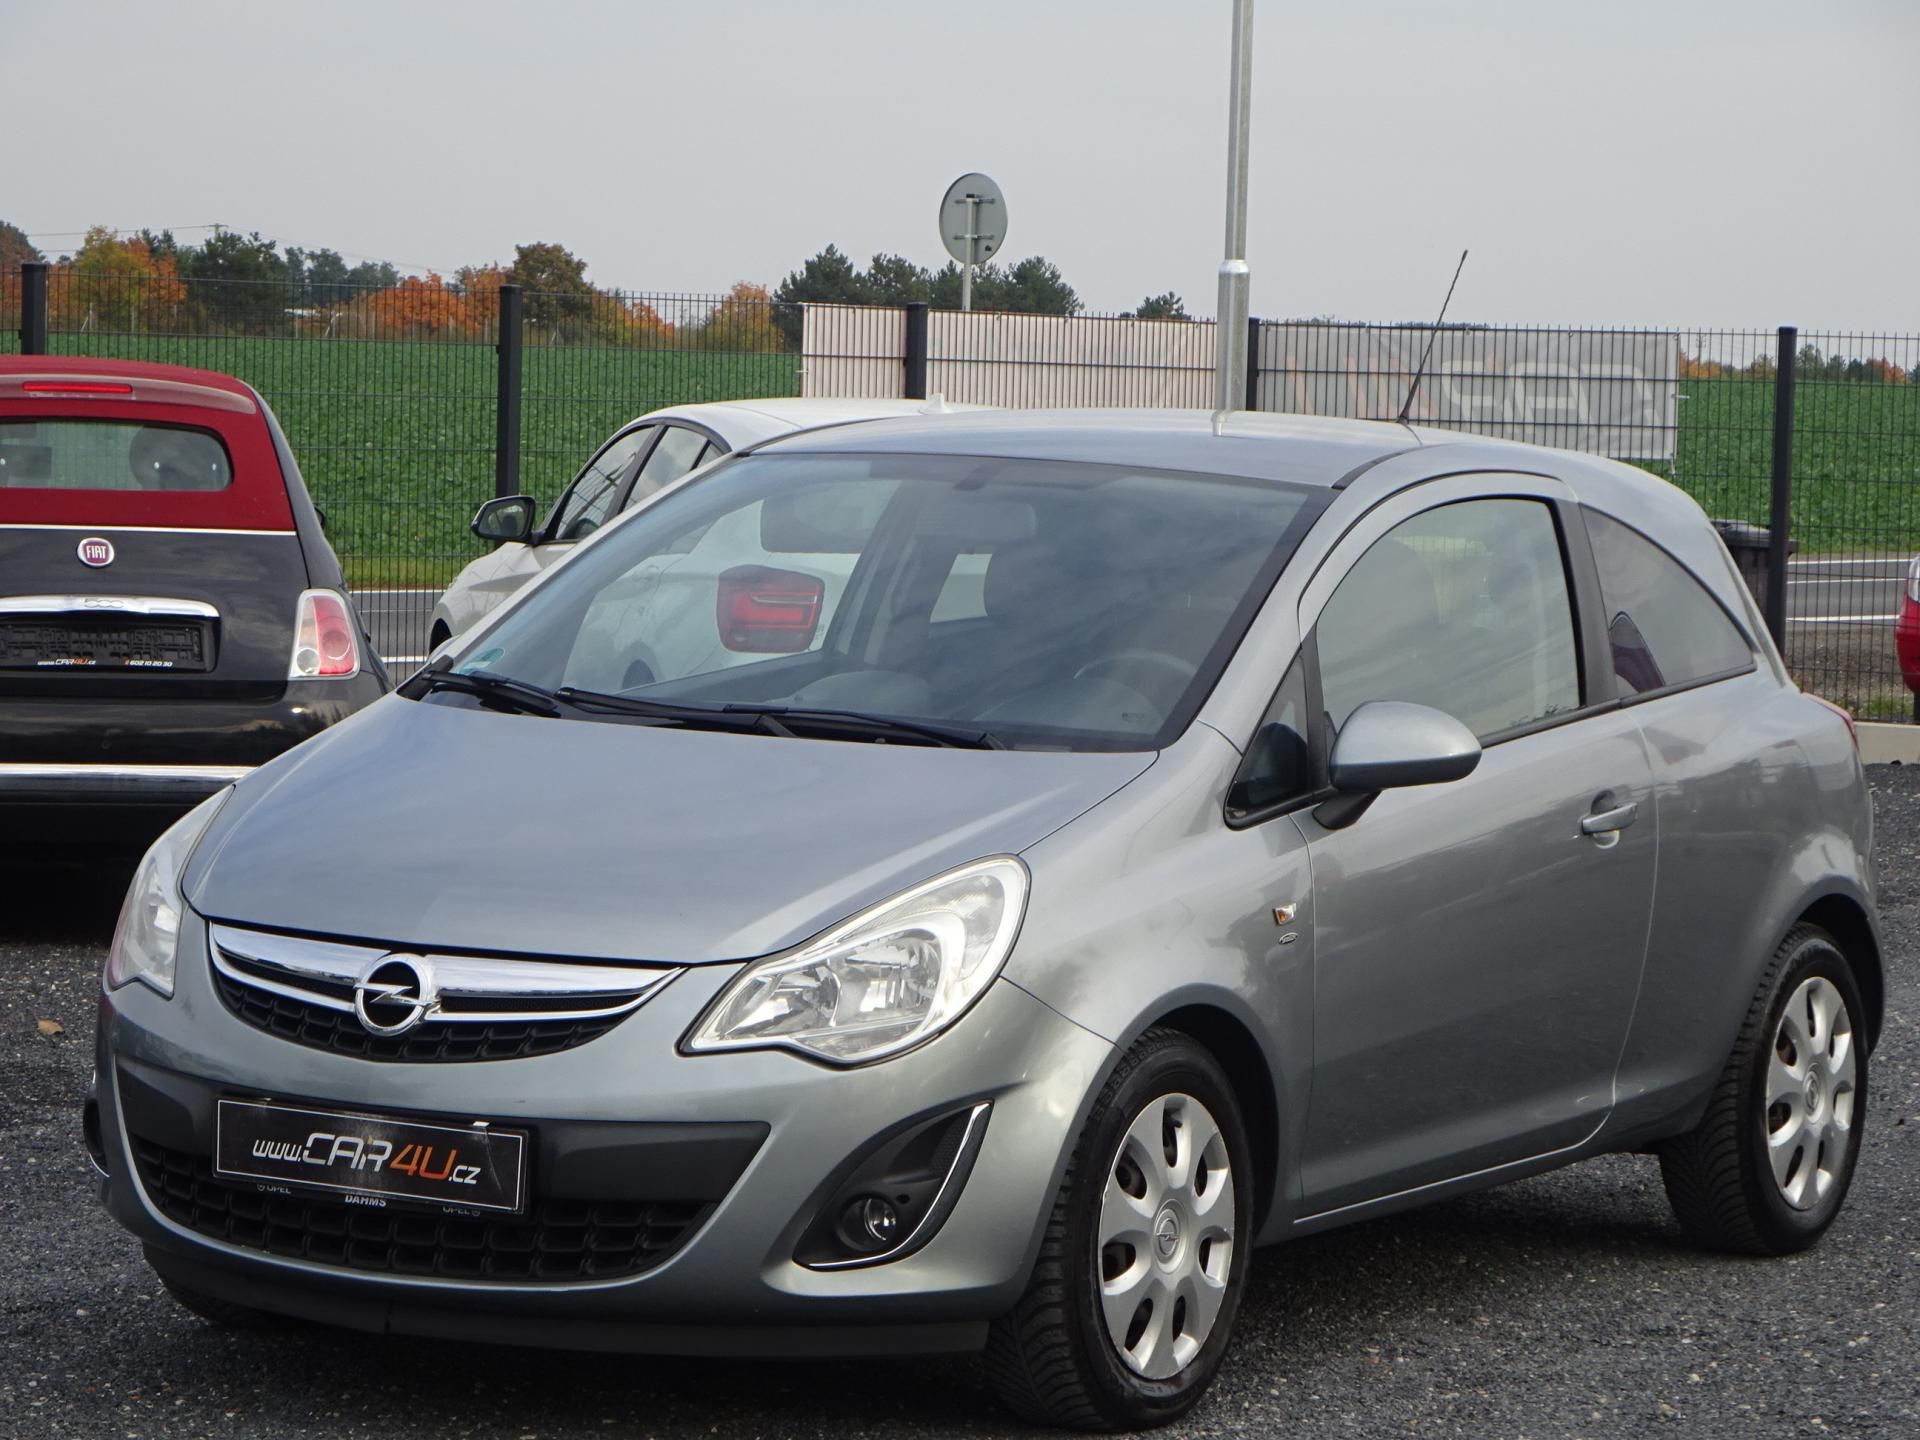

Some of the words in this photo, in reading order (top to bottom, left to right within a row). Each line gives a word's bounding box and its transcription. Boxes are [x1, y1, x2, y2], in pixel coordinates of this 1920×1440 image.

[86, 545, 107, 559] FIAT
[252, 1132, 482, 1185] www.CAR4U.cz
[344, 1194, 387, 1207] DAHMS
